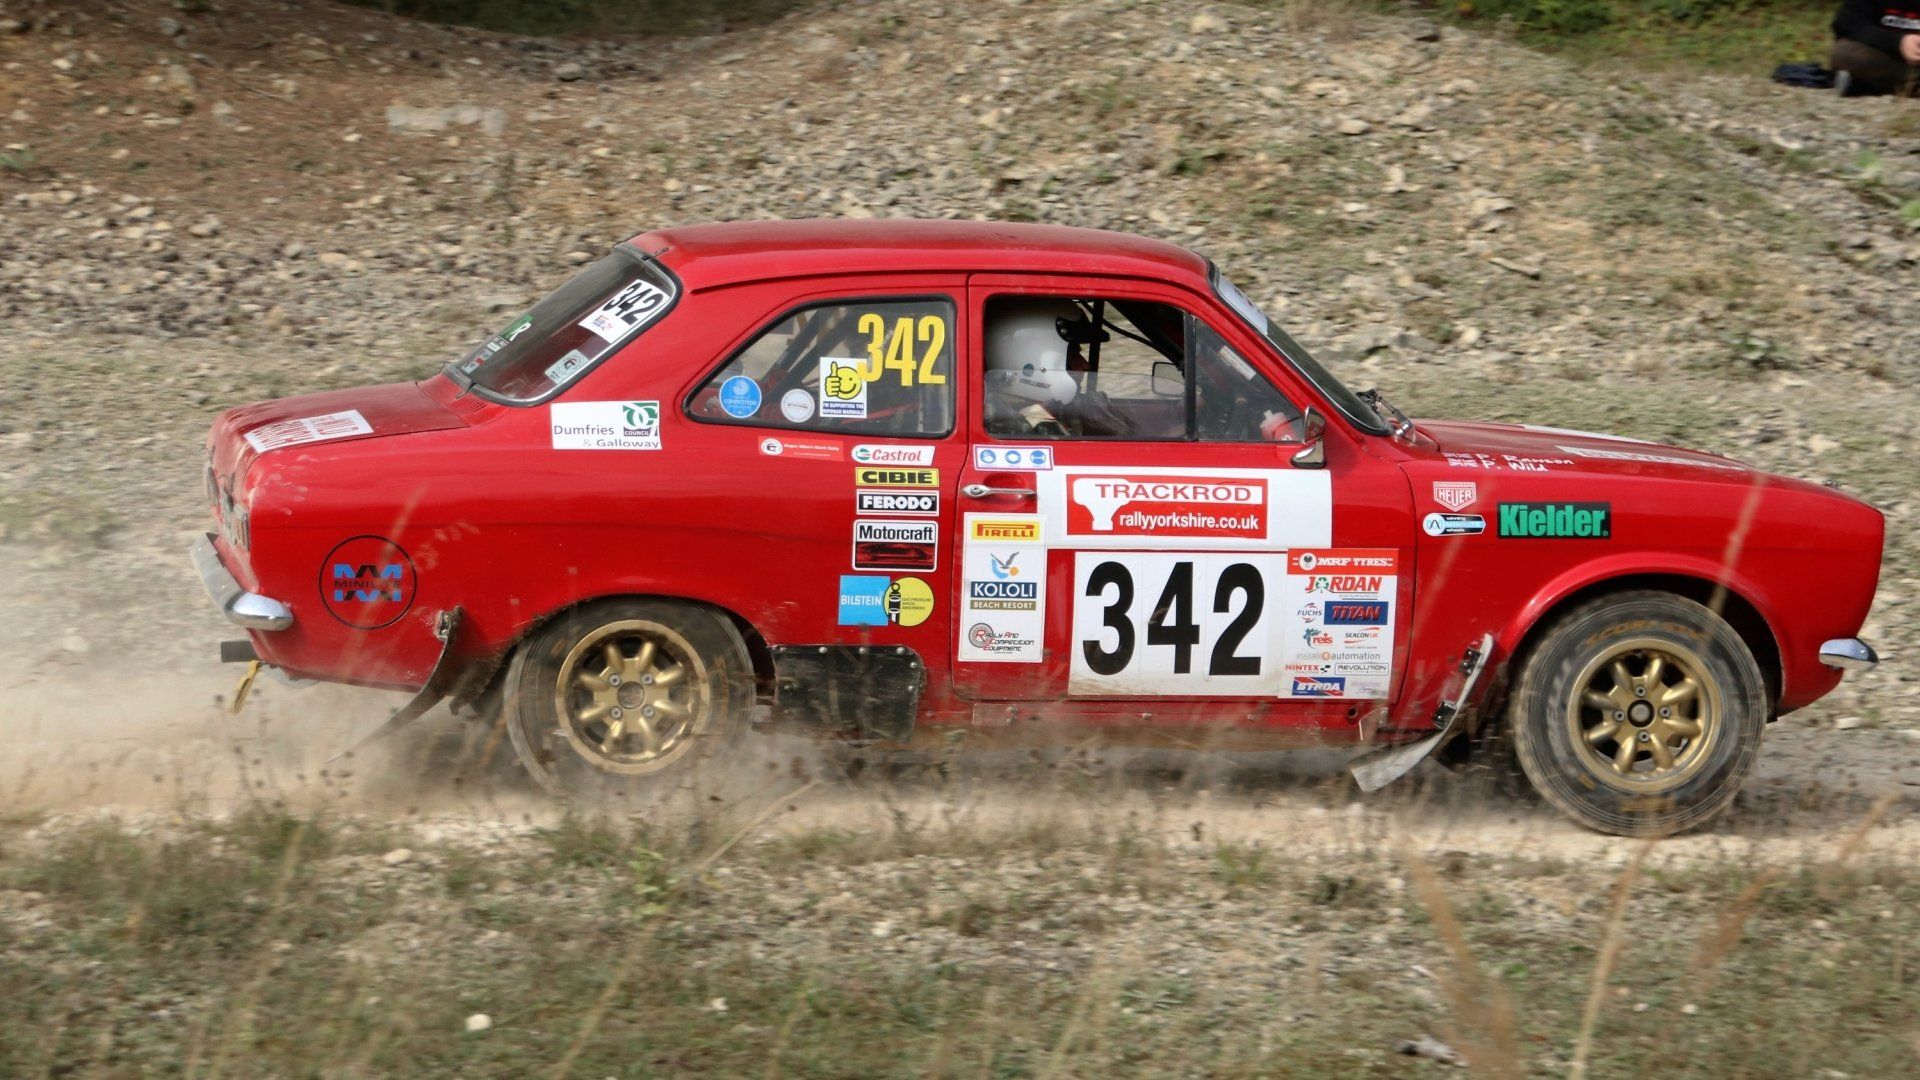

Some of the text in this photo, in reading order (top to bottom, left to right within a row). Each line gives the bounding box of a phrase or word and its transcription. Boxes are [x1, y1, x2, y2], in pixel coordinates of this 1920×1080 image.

[602, 282, 664, 325] 342
[857, 313, 946, 386] 342
[554, 424, 615, 435] Dumfries
[583, 439, 659, 449] & Galloway
[872, 449, 922, 462] Castrol
[1095, 484, 1252, 501] TRACKROD
[1438, 489, 1473, 507] HEUER
[862, 495, 933, 510] FERODO
[1119, 511, 1259, 530] rallyyorkshire.co.uk
[859, 525, 934, 540] Motorcraft
[976, 523, 1035, 538] PIRELLI
[1316, 557, 1388, 567] MRF TYRES
[974, 582, 1033, 597] KOLOLI
[840, 594, 882, 606] BILSTEIN
[1082, 561, 1265, 676] 342
[1312, 633, 1334, 644] reis
